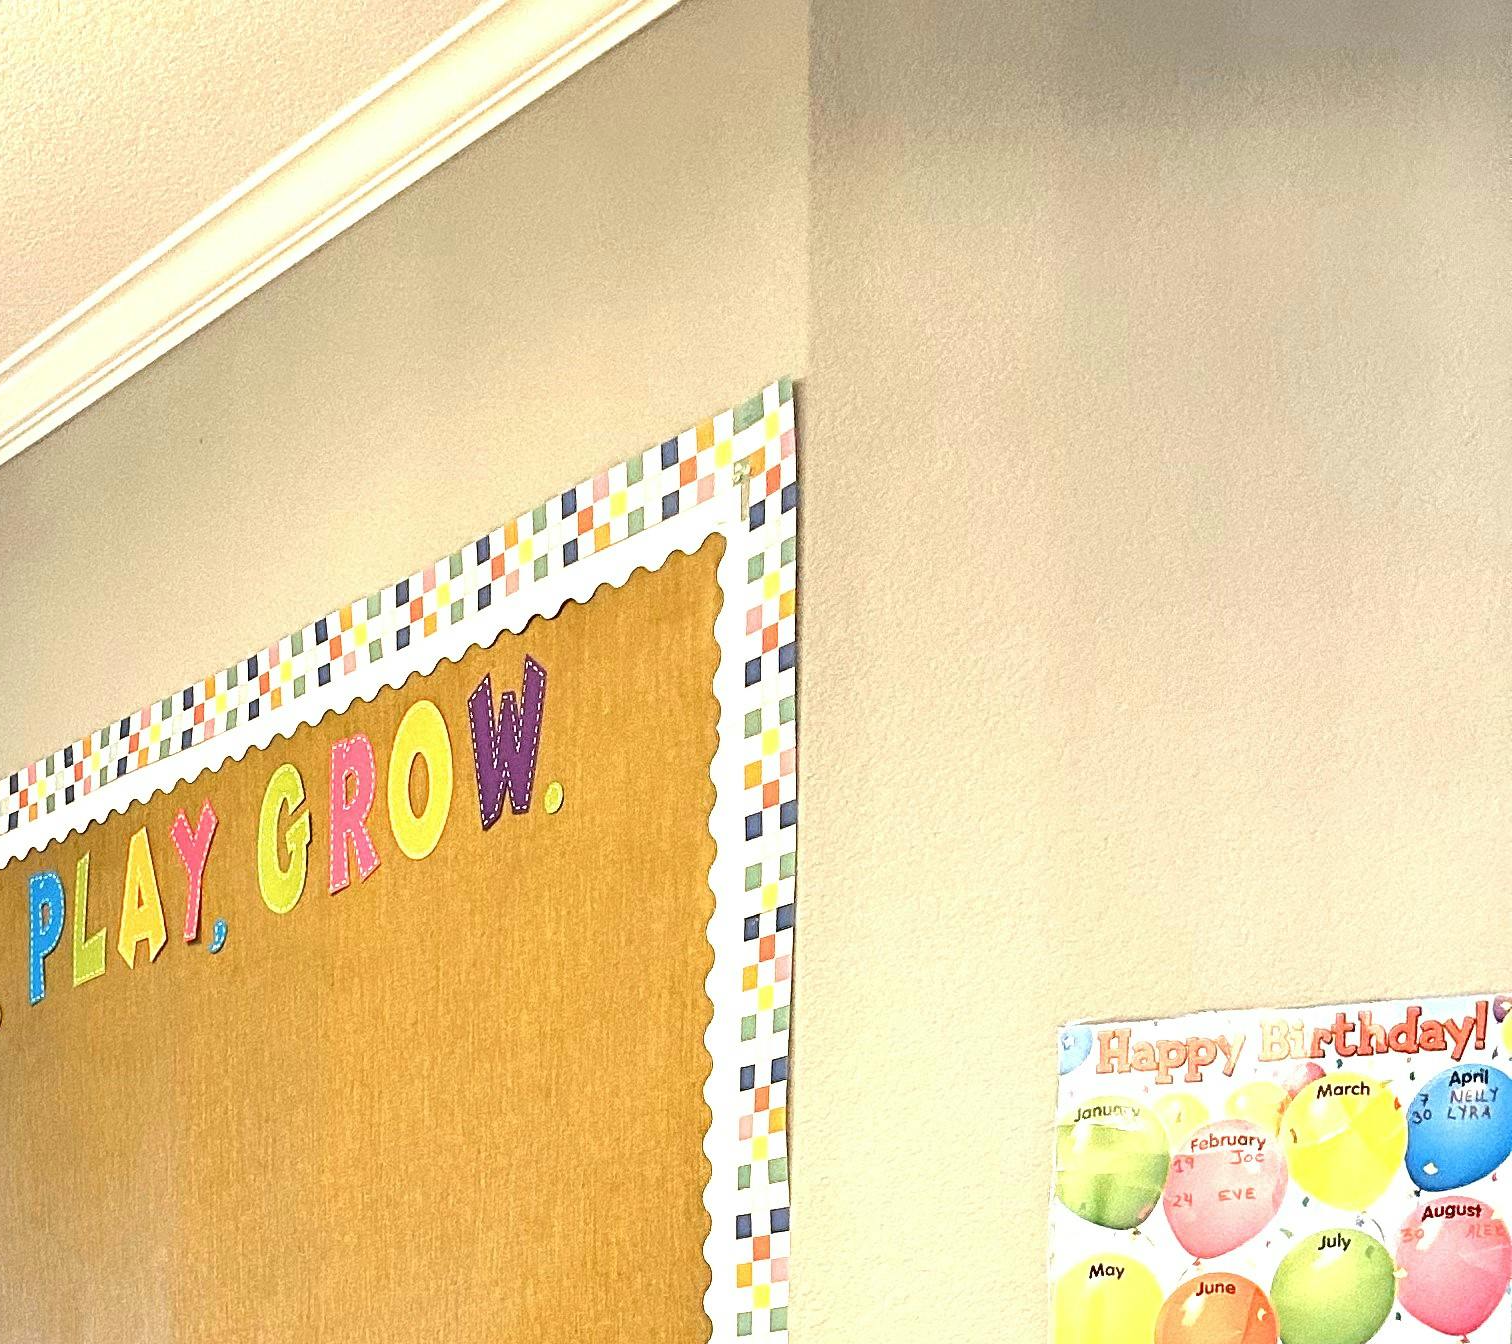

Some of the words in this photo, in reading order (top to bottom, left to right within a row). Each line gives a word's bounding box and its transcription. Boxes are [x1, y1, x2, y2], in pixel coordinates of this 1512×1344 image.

[27, 798, 228, 1003] PLAY,
[257, 653, 564, 914] GROW.
[1096, 1027, 1246, 1085] Happy
[1257, 1000, 1489, 1061] Birthday!
[1449, 1068, 1489, 1087] April
[1317, 1081, 1370, 1099] March
[1412, 1108, 1432, 1125] 30
[1448, 1105, 1491, 1120] LYRA
[1191, 1133, 1266, 1152] February
[1218, 1187, 1256, 1201] EVE
[1421, 1204, 1482, 1222] August
[1318, 1232, 1351, 1251] July
[1089, 1263, 1125, 1280] May
[1196, 1281, 1236, 1296] June
